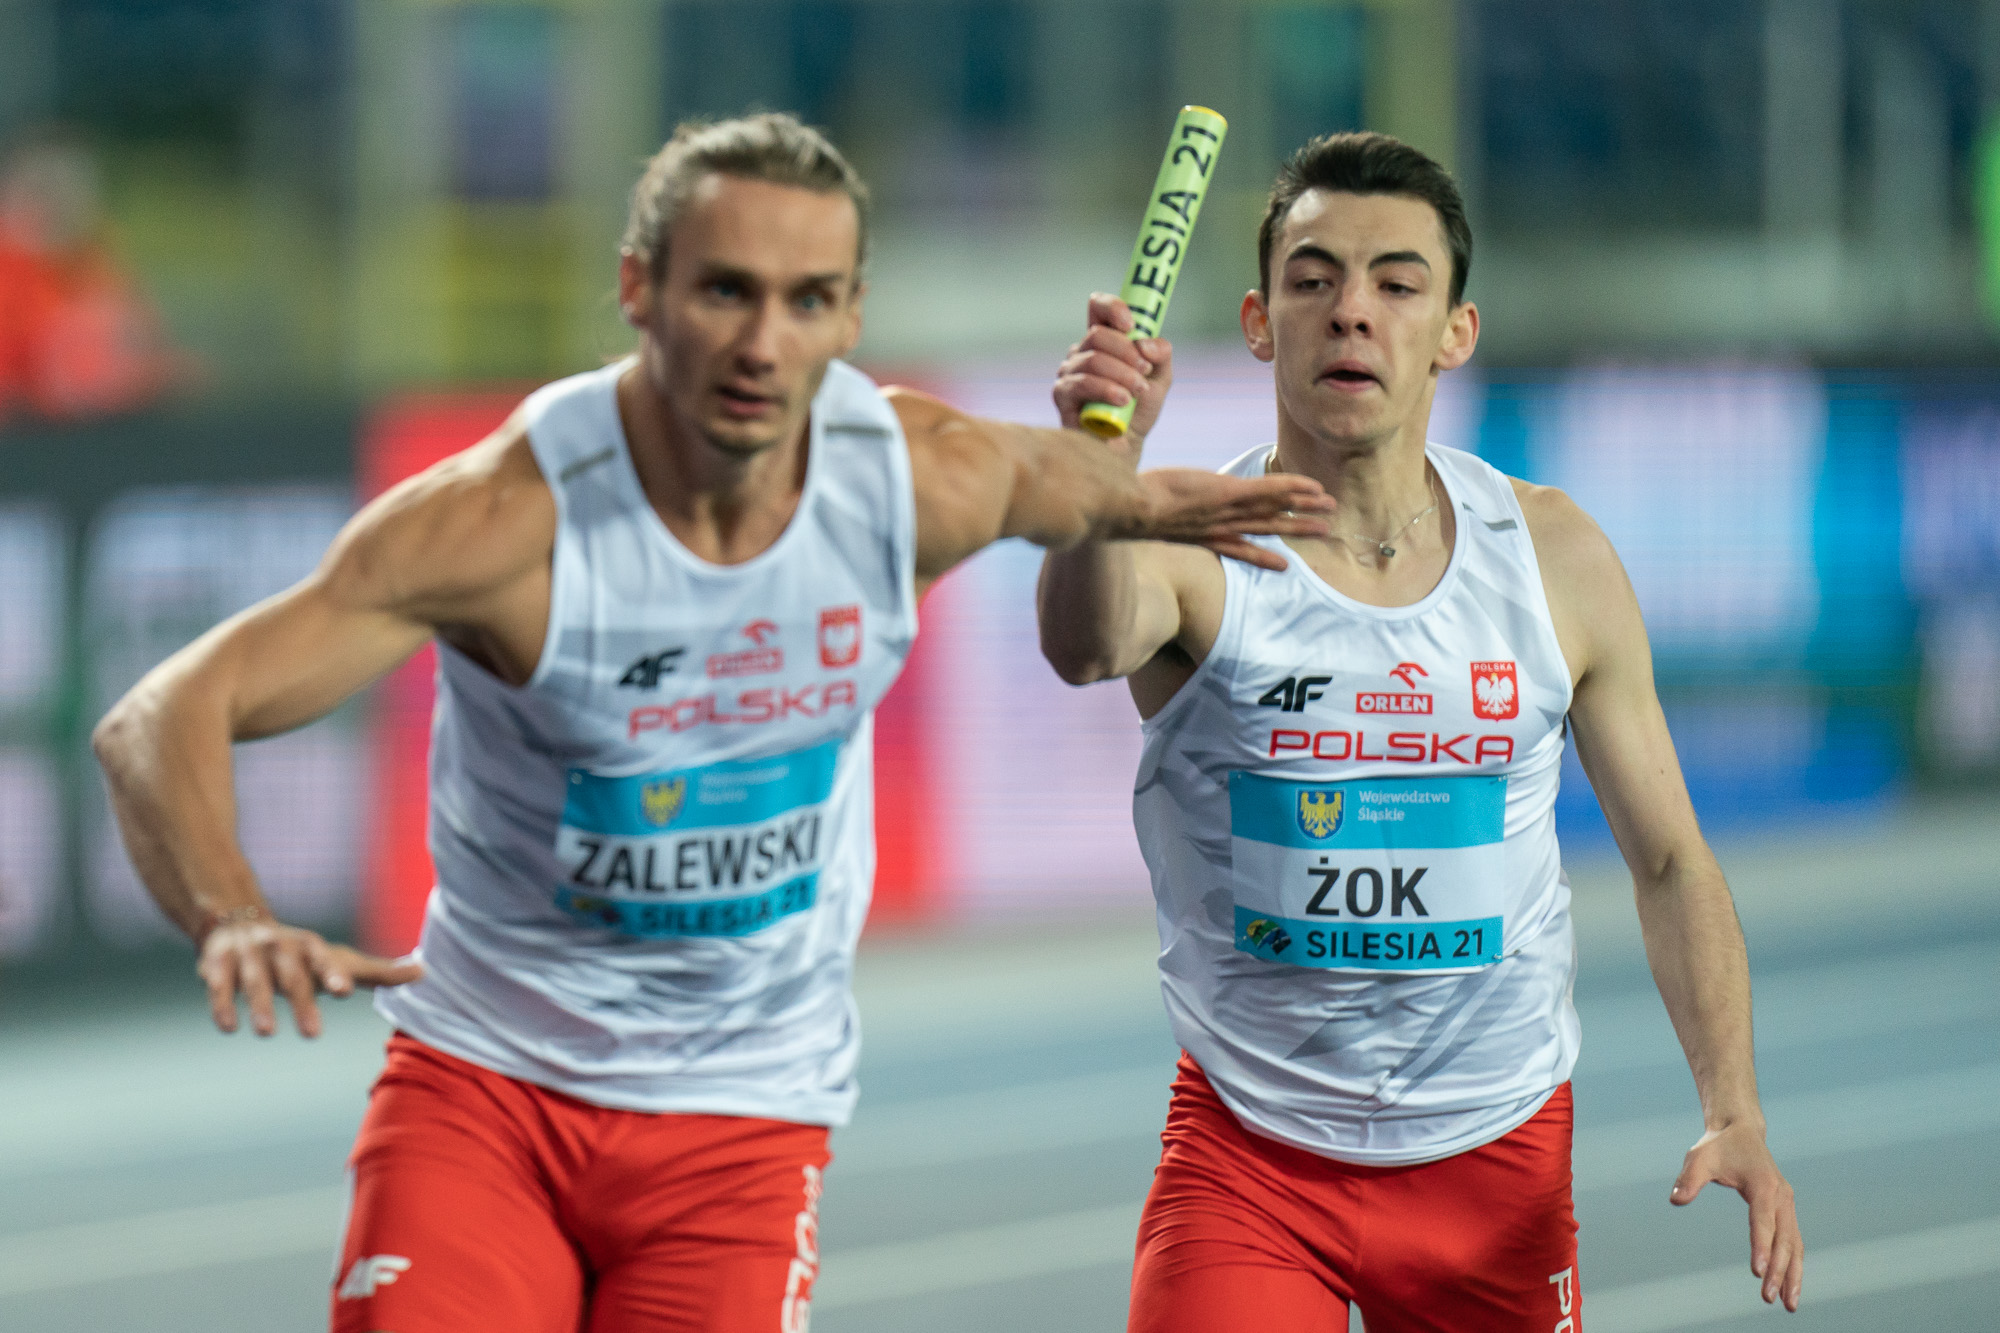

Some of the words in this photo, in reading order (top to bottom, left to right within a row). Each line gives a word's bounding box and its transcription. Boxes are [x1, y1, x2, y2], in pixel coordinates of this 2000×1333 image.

[1172, 124, 1218, 178] 21
[619, 647, 685, 688] 4F
[1473, 663, 1513, 672] POLSKA
[629, 681, 855, 739] POLSKA
[1258, 675, 1333, 713] 4F
[1359, 695, 1429, 713] ORLEN
[1269, 729, 1514, 765] POLSKA
[1358, 805, 1405, 824] Śląskie
[1359, 790, 1450, 805] Województwo
[571, 815, 820, 892] ZALEWSKI
[1305, 856, 1429, 917] ŻOK
[1306, 930, 1441, 960] SILESIA
[1453, 928, 1483, 957] 21
[340, 1254, 411, 1300] 4F
